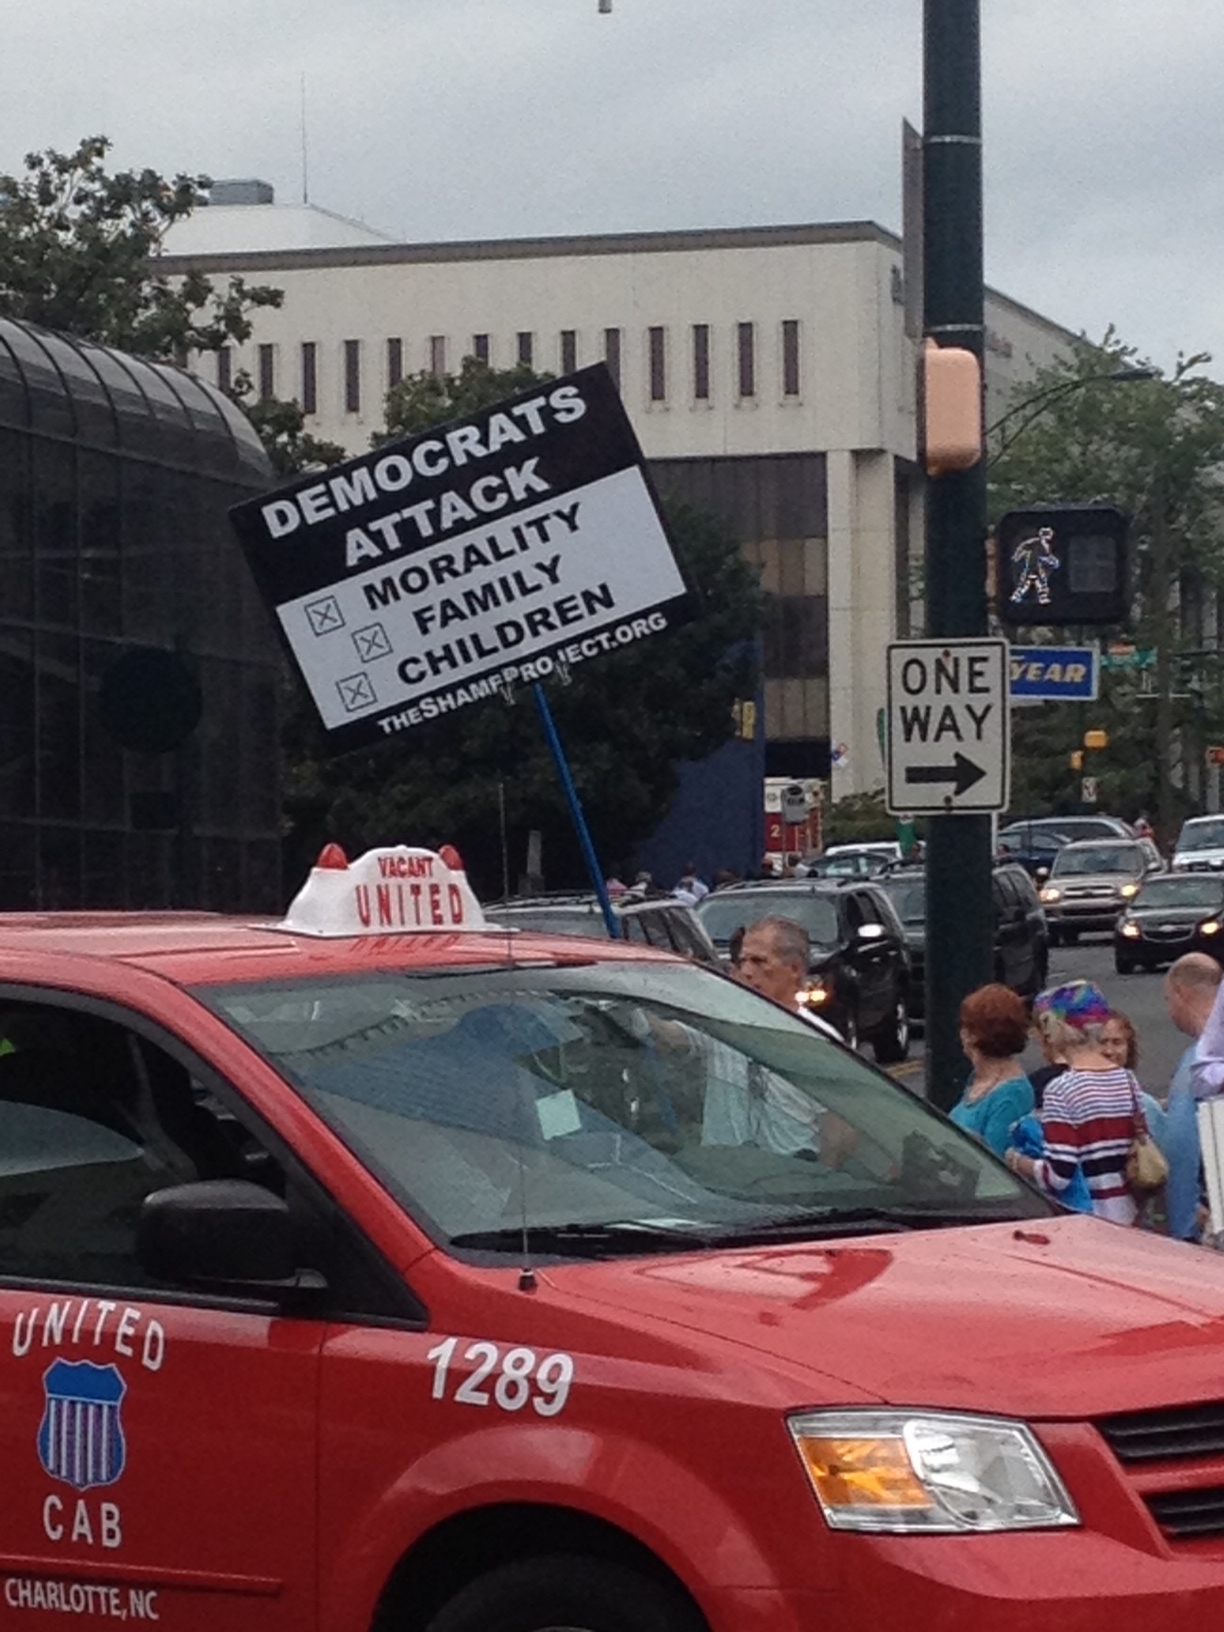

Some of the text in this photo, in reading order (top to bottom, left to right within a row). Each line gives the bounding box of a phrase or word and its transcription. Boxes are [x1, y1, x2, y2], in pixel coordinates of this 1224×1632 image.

[261, 385, 587, 539] DEMOCRATS
[345, 457, 550, 567] ATTACK
[363, 502, 582, 611] MORALITY
[412, 554, 563, 636] FAMILY
[397, 583, 616, 685] CHILDREN
[902, 656, 991, 696] ONE
[900, 704, 992, 743] WAY
[378, 857, 433, 877] VACANT
[356, 883, 463, 927] UNITED
[12, 1299, 165, 1371] UNITED
[427, 1337, 574, 1416] 1289
[43, 1495, 121, 1548] CAB
